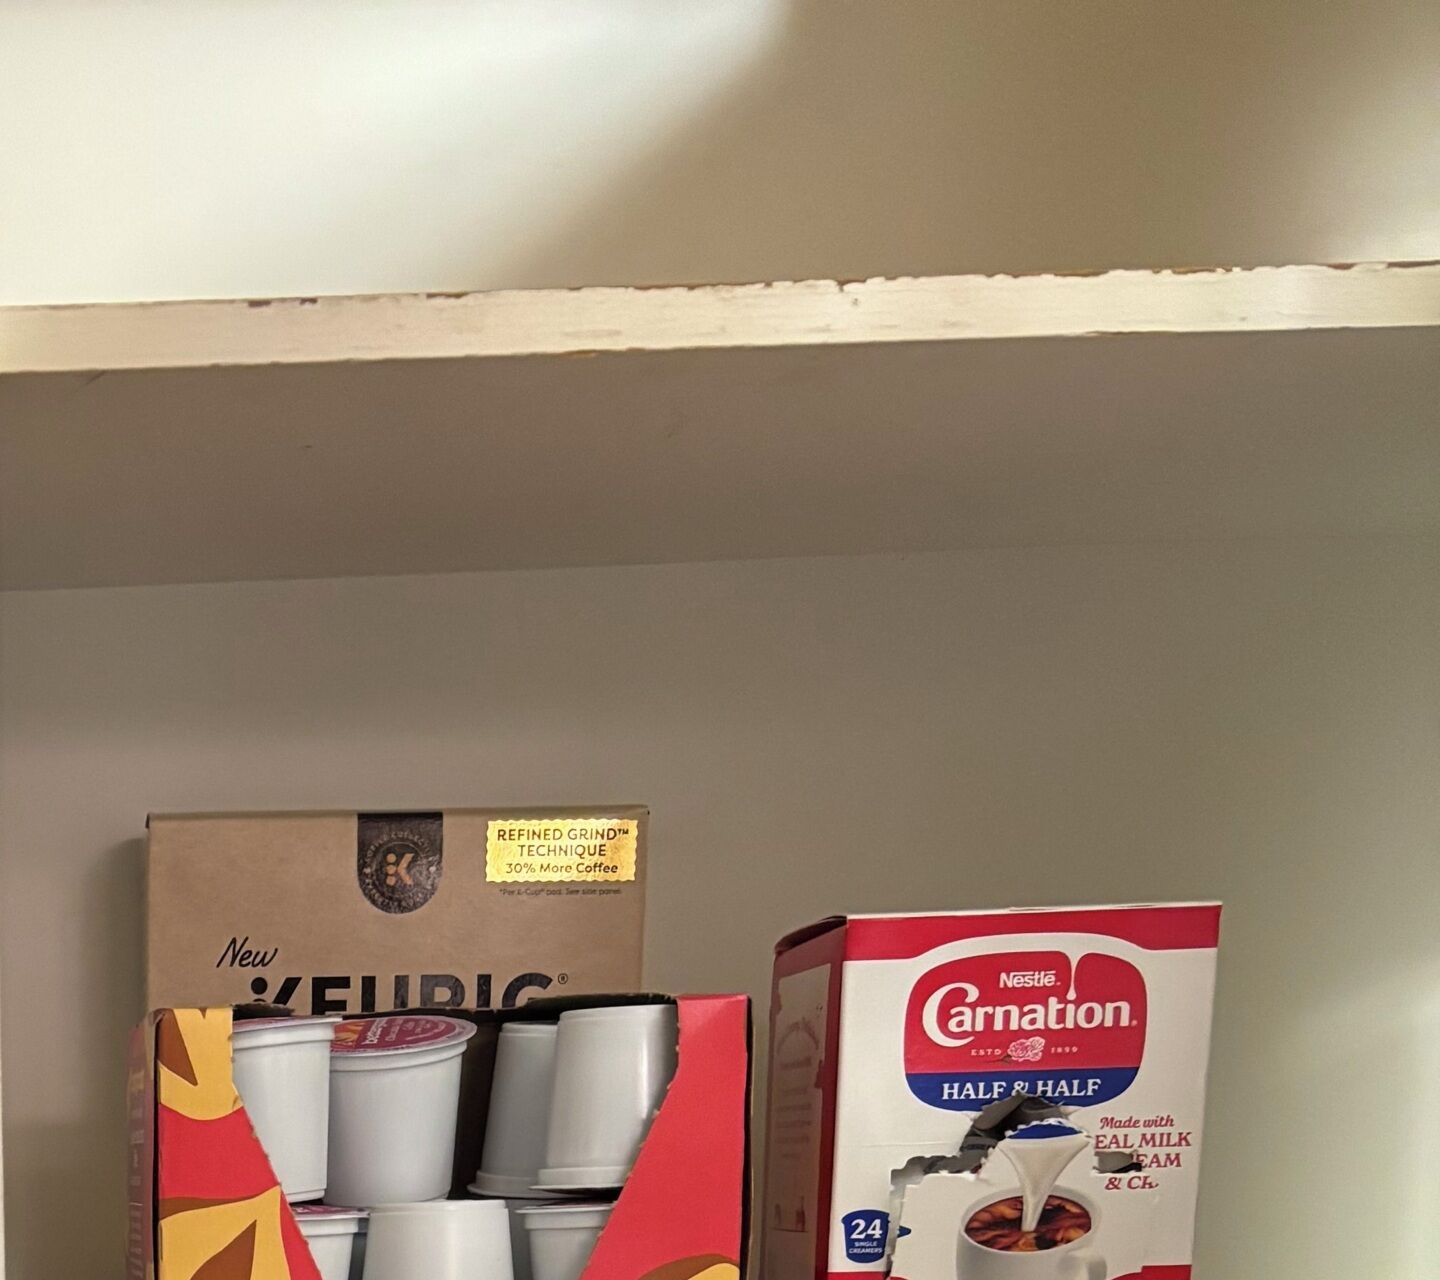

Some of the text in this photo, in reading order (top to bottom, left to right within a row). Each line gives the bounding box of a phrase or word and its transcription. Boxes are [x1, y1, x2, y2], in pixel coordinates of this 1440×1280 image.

[496, 827, 563, 842] REFINED
[517, 843, 607, 858] TECHNIQUE
[505, 861, 619, 874] 30% More Coffee
[215, 936, 279, 968] New
[922, 982, 1132, 1047] Carnation
[941, 1078, 1102, 1100] HALF & HALF
[1099, 1114, 1175, 1130] Made with
[1095, 1131, 1193, 1150] EAL MILK
[1104, 1176, 1123, 1191] &
[849, 1218, 883, 1239] 24
